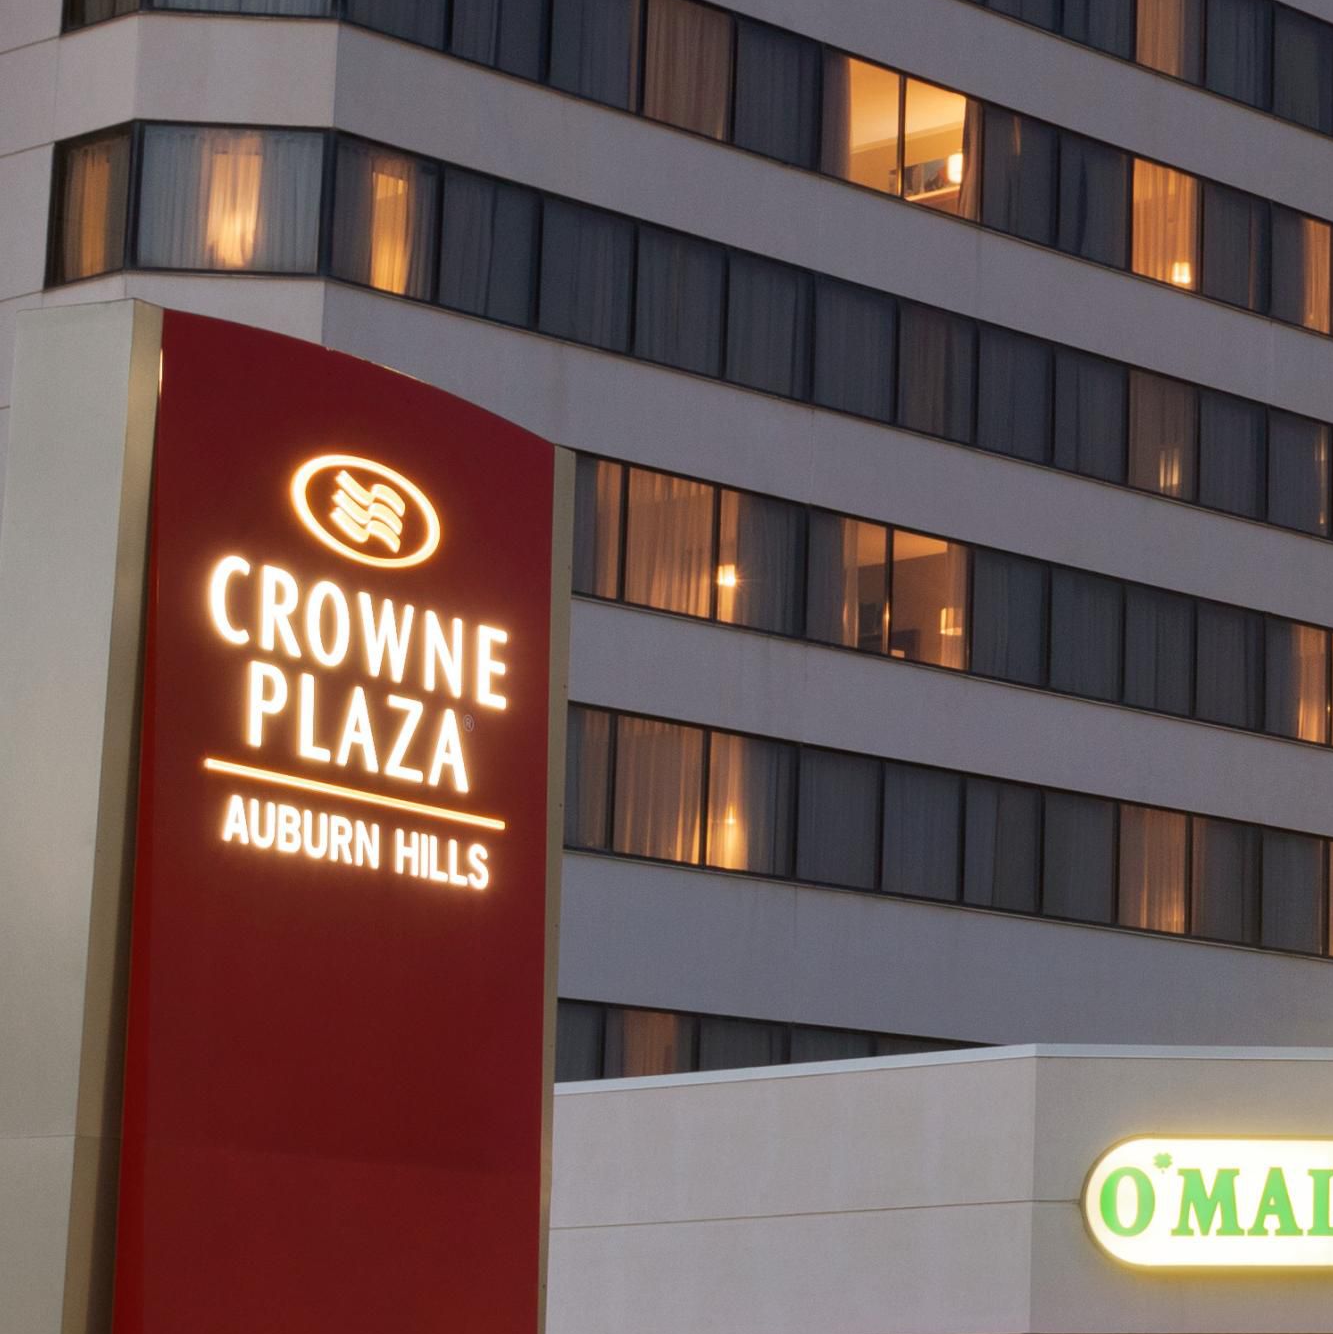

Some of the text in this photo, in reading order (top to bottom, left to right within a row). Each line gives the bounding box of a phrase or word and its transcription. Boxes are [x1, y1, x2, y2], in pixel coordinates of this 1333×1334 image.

[207, 553, 509, 711] CROWNE
[246, 659, 471, 795] PLAZA
[221, 793, 491, 891] AUBURN HILLS
